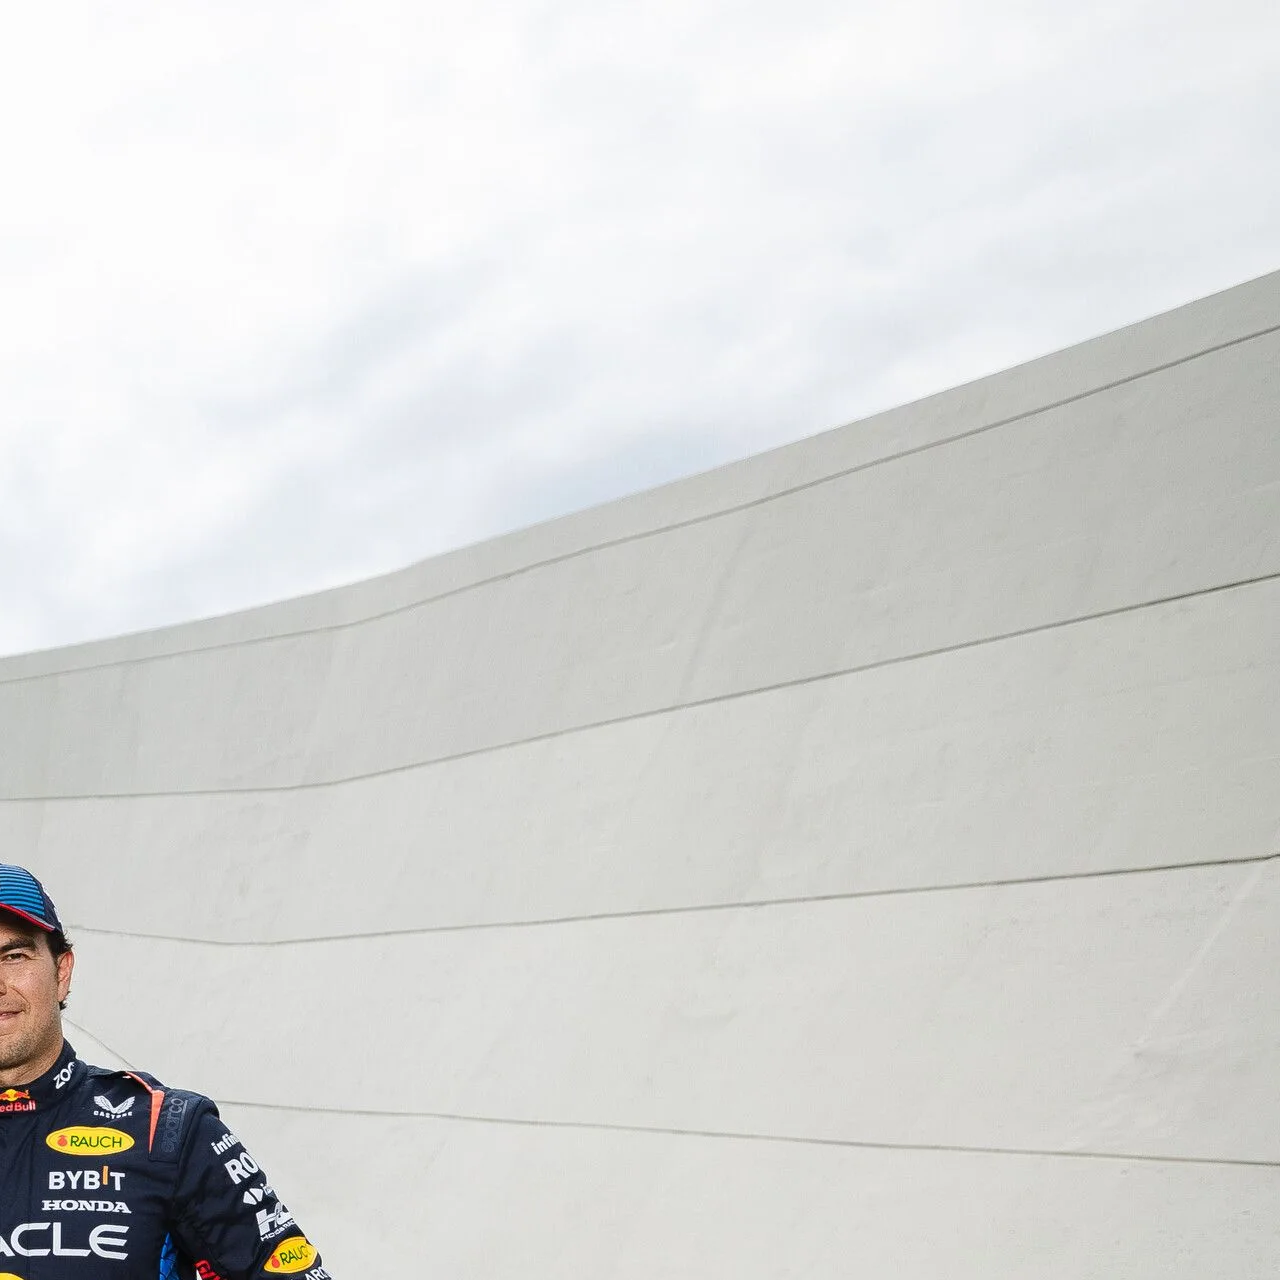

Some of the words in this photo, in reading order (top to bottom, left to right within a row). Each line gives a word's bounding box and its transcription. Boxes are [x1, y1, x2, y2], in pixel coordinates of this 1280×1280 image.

[14, 1100, 36, 1112] Bull
[93, 1110, 133, 1119] CASTORE
[70, 1135, 122, 1148] RAUCH
[49, 1165, 126, 1191] BYBIT
[41, 1200, 132, 1213] HONDA
